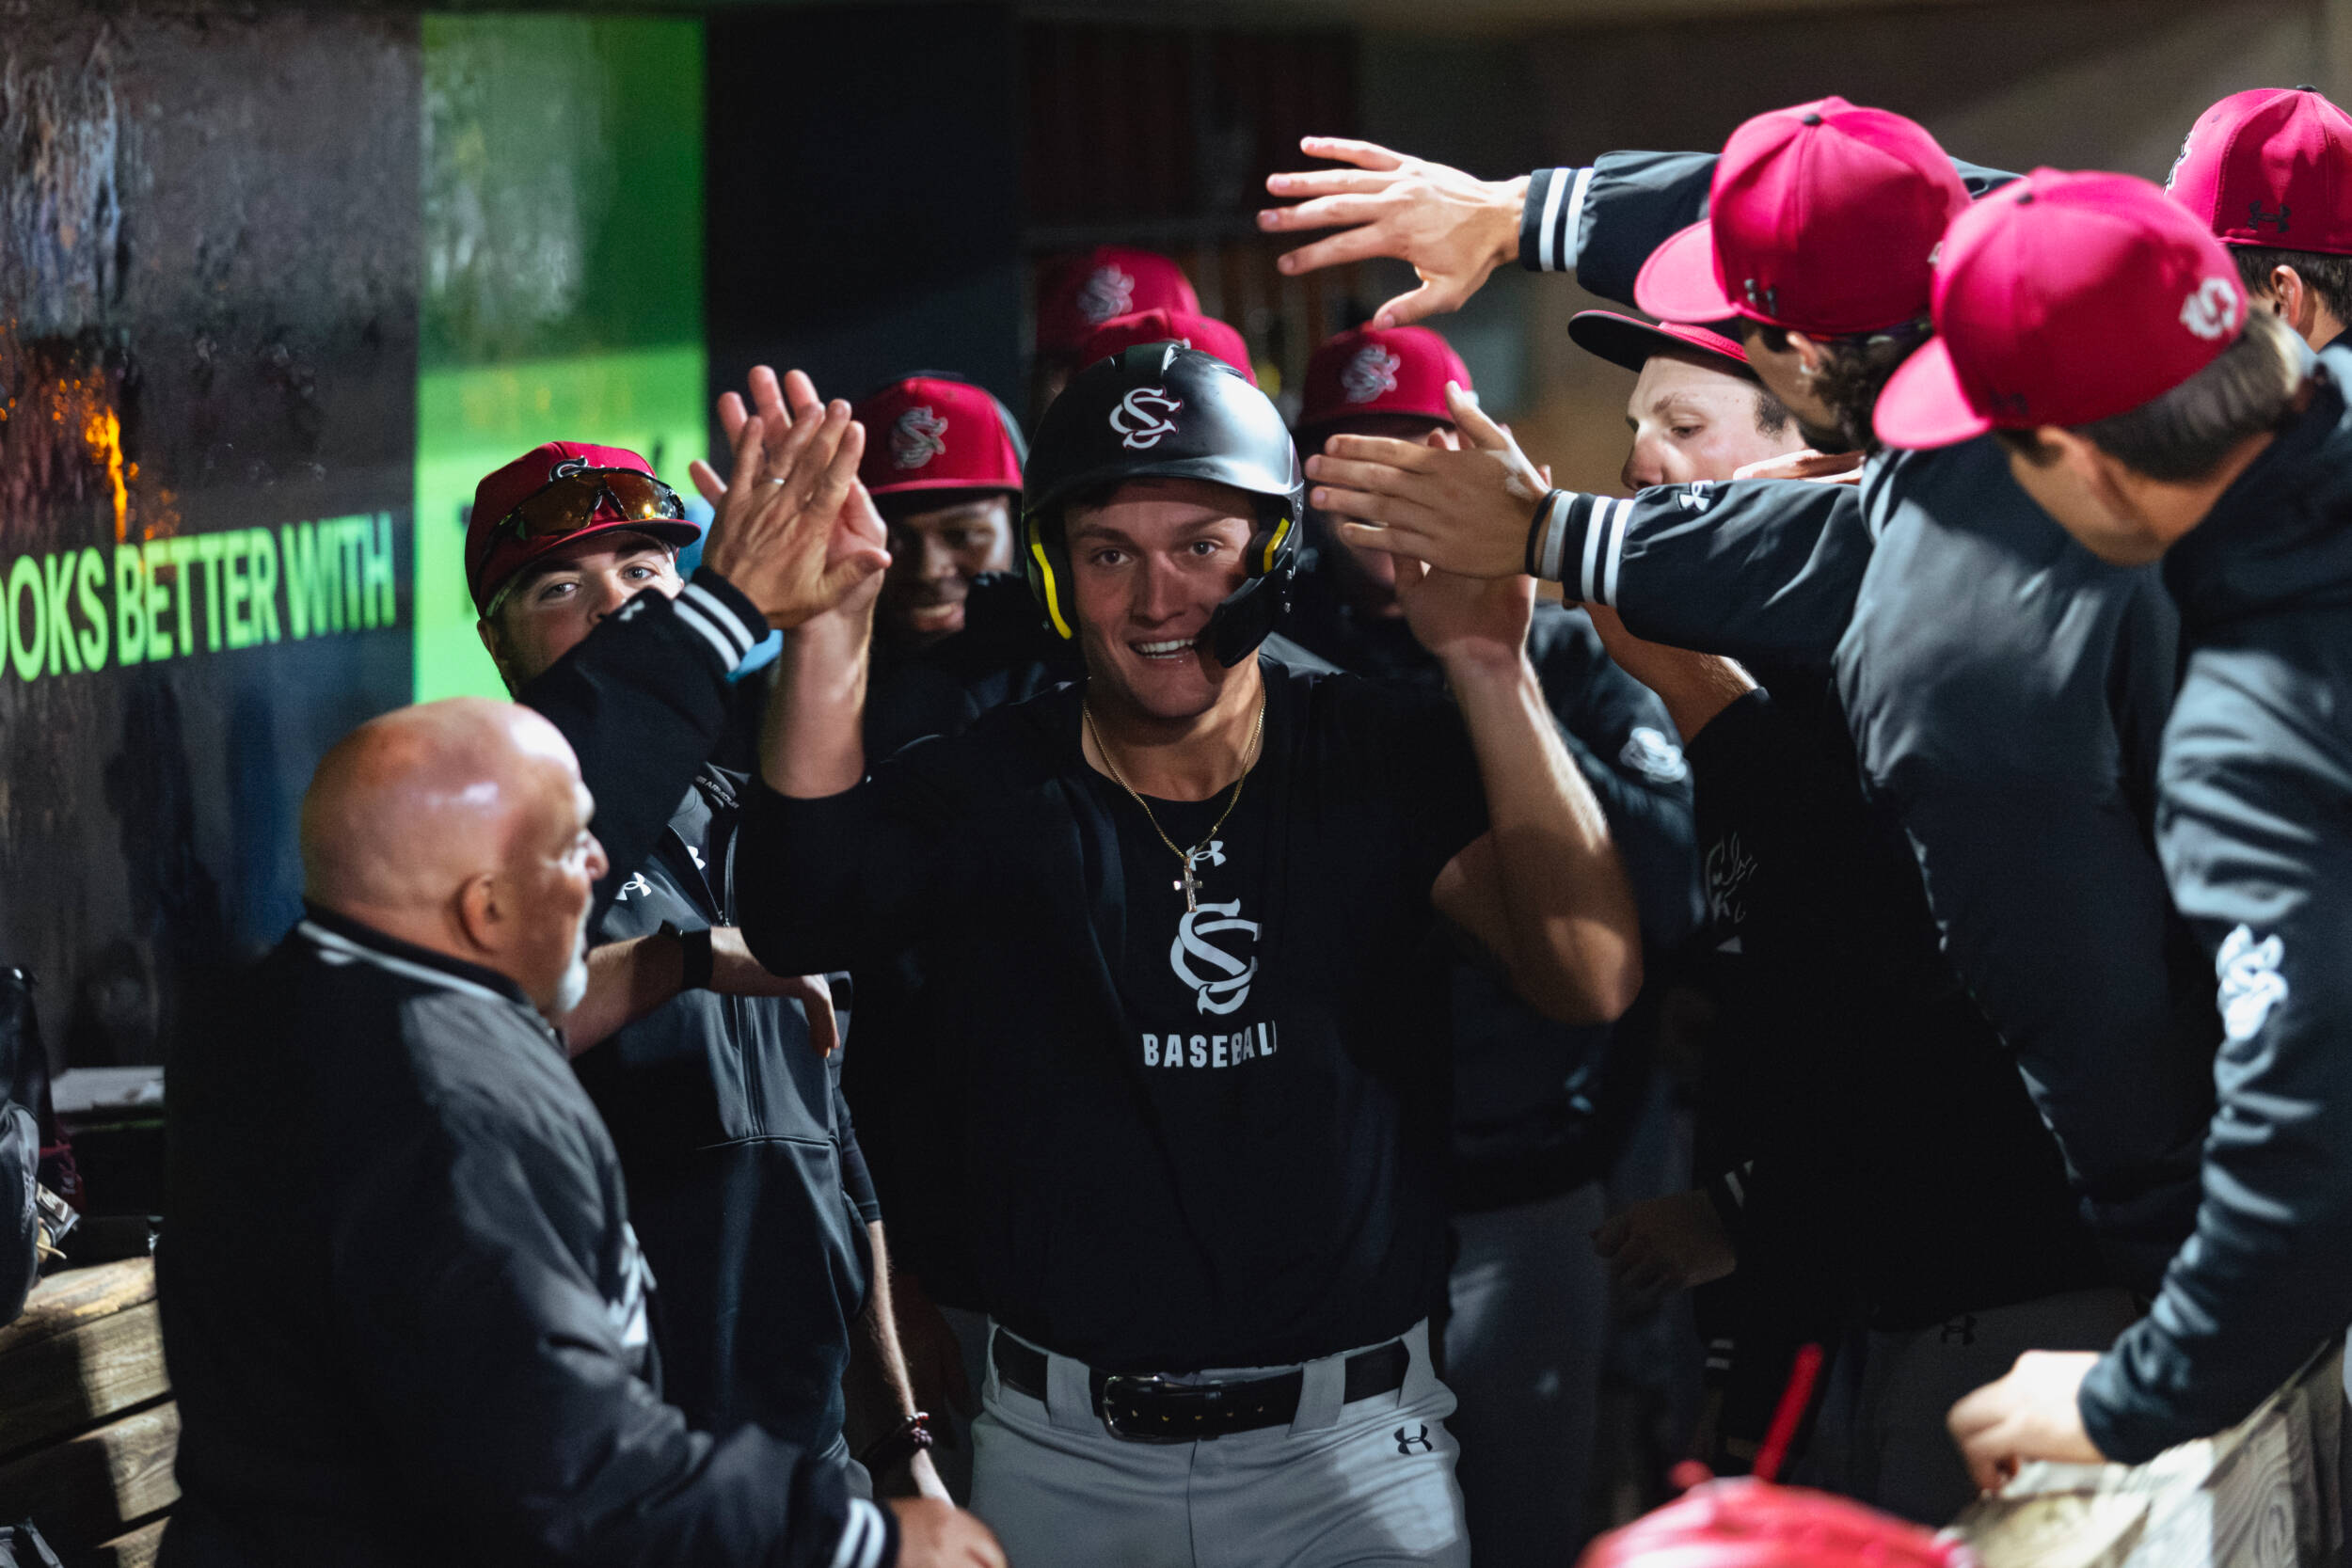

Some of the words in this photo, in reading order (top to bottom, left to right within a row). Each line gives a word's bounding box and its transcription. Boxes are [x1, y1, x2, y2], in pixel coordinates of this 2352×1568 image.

[1108, 386, 1184, 450] SC
[0, 546, 109, 682] OKS
[115, 527, 281, 666] BETTER
[281, 511, 396, 641] WITH
[1170, 897, 1263, 1016] SC
[1142, 1020, 1278, 1069] BASEBAL
